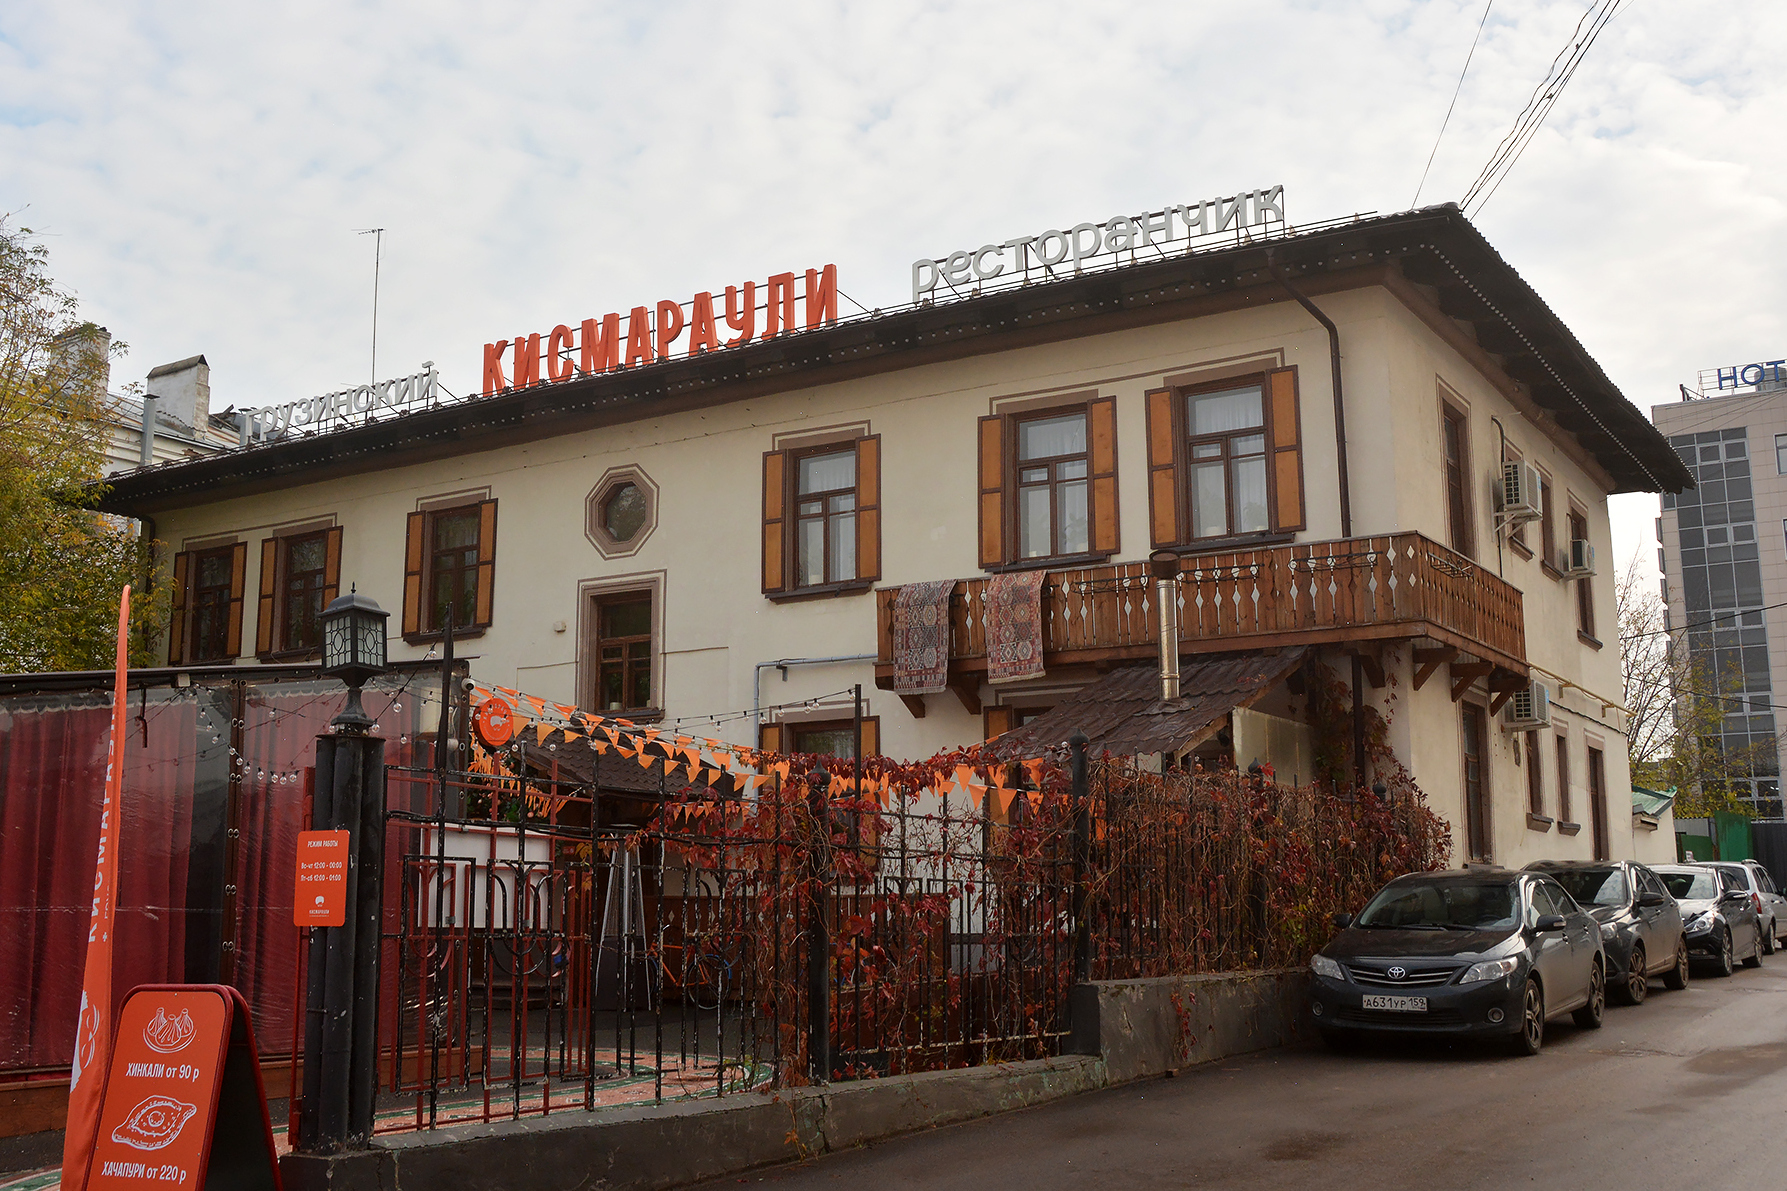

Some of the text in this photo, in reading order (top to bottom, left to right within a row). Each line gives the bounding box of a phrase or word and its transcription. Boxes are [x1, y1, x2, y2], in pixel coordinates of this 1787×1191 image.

[246, 184, 1284, 442] грузинский КИСМАРАУЛИ ресторанчик
[314, 861, 325, 869] 12:00
[329, 861, 342, 869] 00:00
[1409, 998, 1424, 1007] 159
[125, 1062, 200, 1083] ХИНКАЛИ от 90 р
[101, 1161, 187, 1185] ХАЧАПУРИ от 220 р
